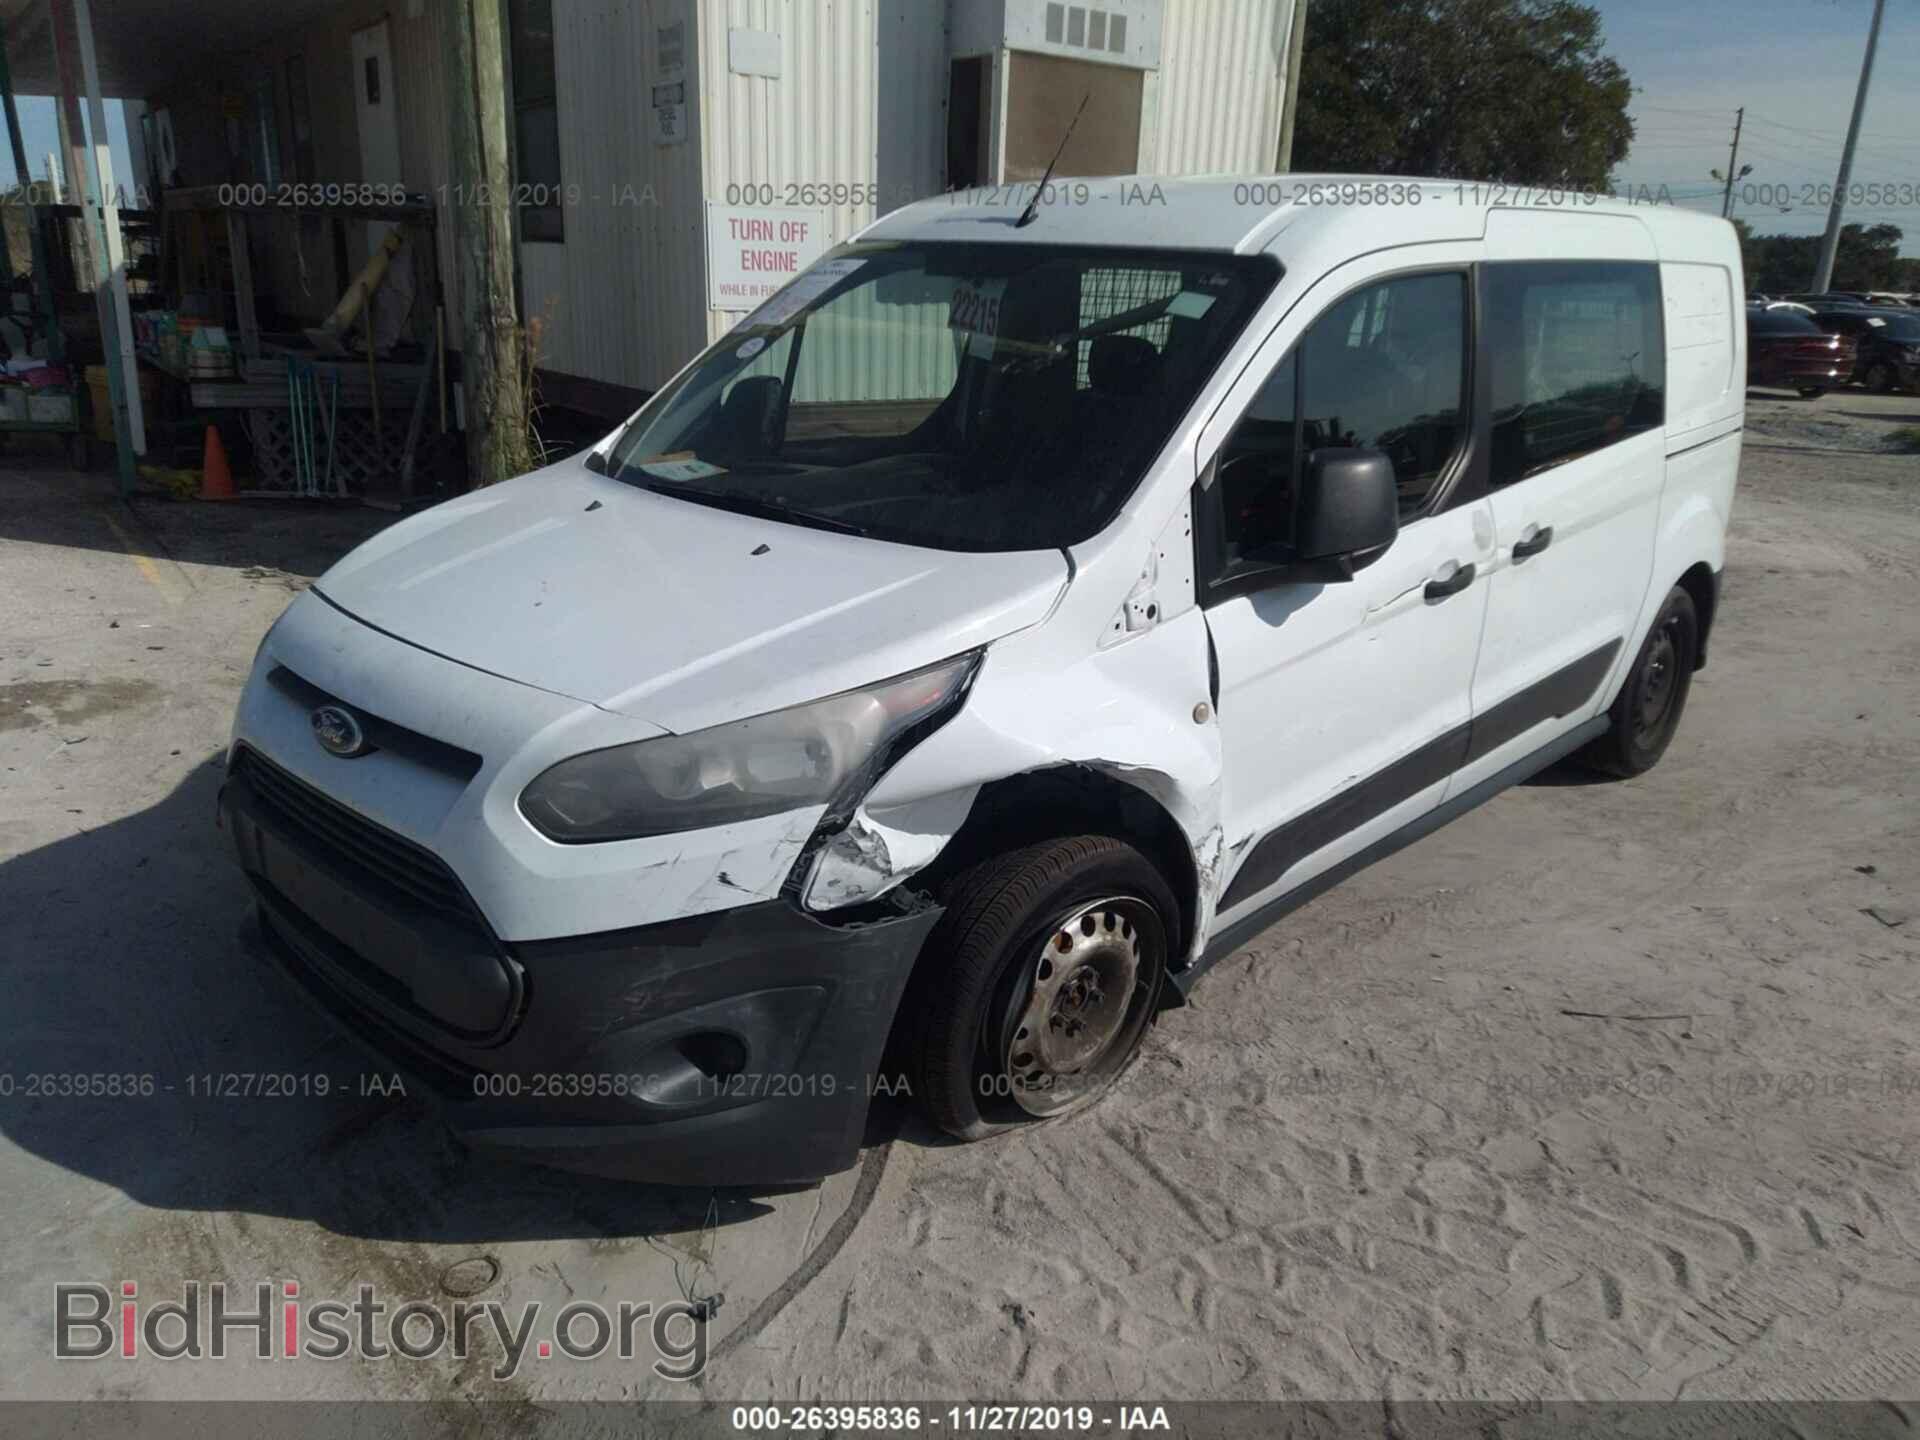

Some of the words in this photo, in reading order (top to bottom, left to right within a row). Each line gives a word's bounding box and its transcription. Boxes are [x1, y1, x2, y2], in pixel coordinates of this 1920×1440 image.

[728, 218, 773, 241] TURN
[780, 221, 809, 242] OFF
[741, 250, 798, 272] ENGINE
[719, 284, 749, 297] WHILE
